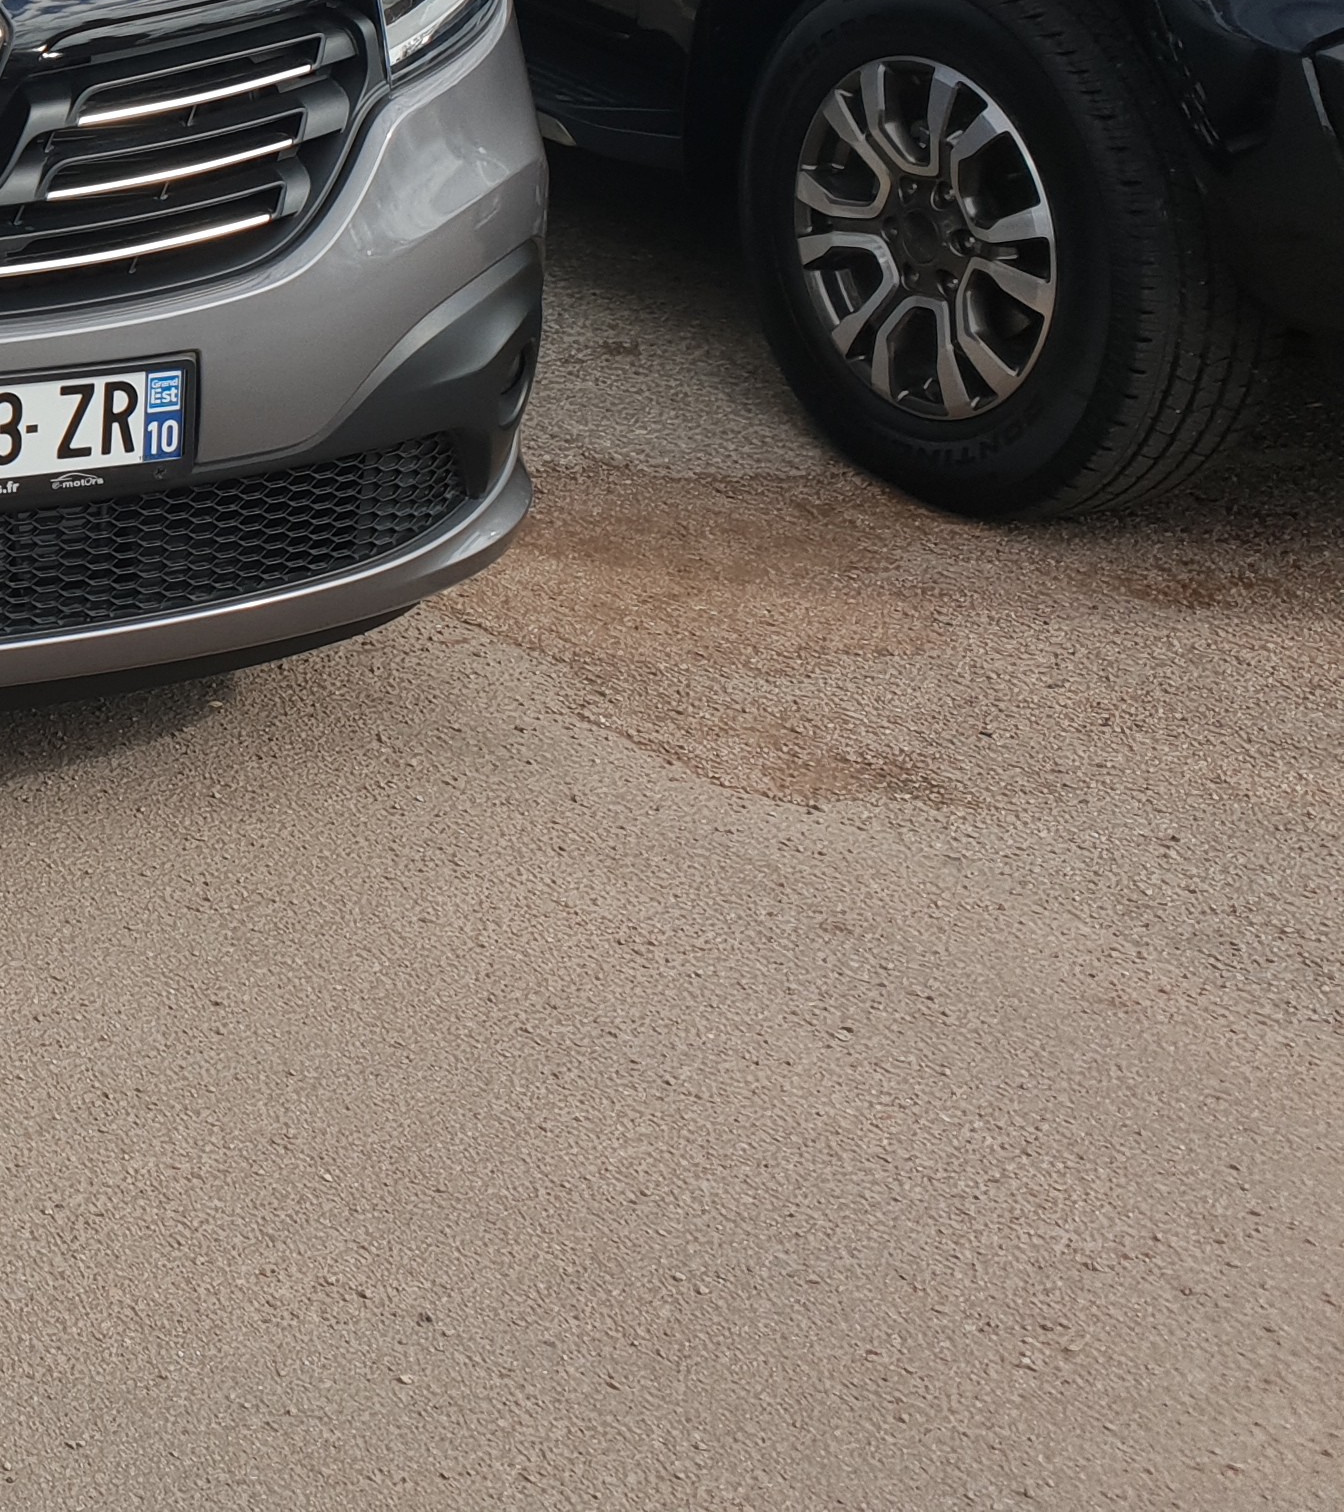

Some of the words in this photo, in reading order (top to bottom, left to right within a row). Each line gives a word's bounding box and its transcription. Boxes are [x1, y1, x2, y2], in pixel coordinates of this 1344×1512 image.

[151, 377, 179, 388] Grand
[150, 387, 178, 404] Est
[147, 419, 179, 455] 10
